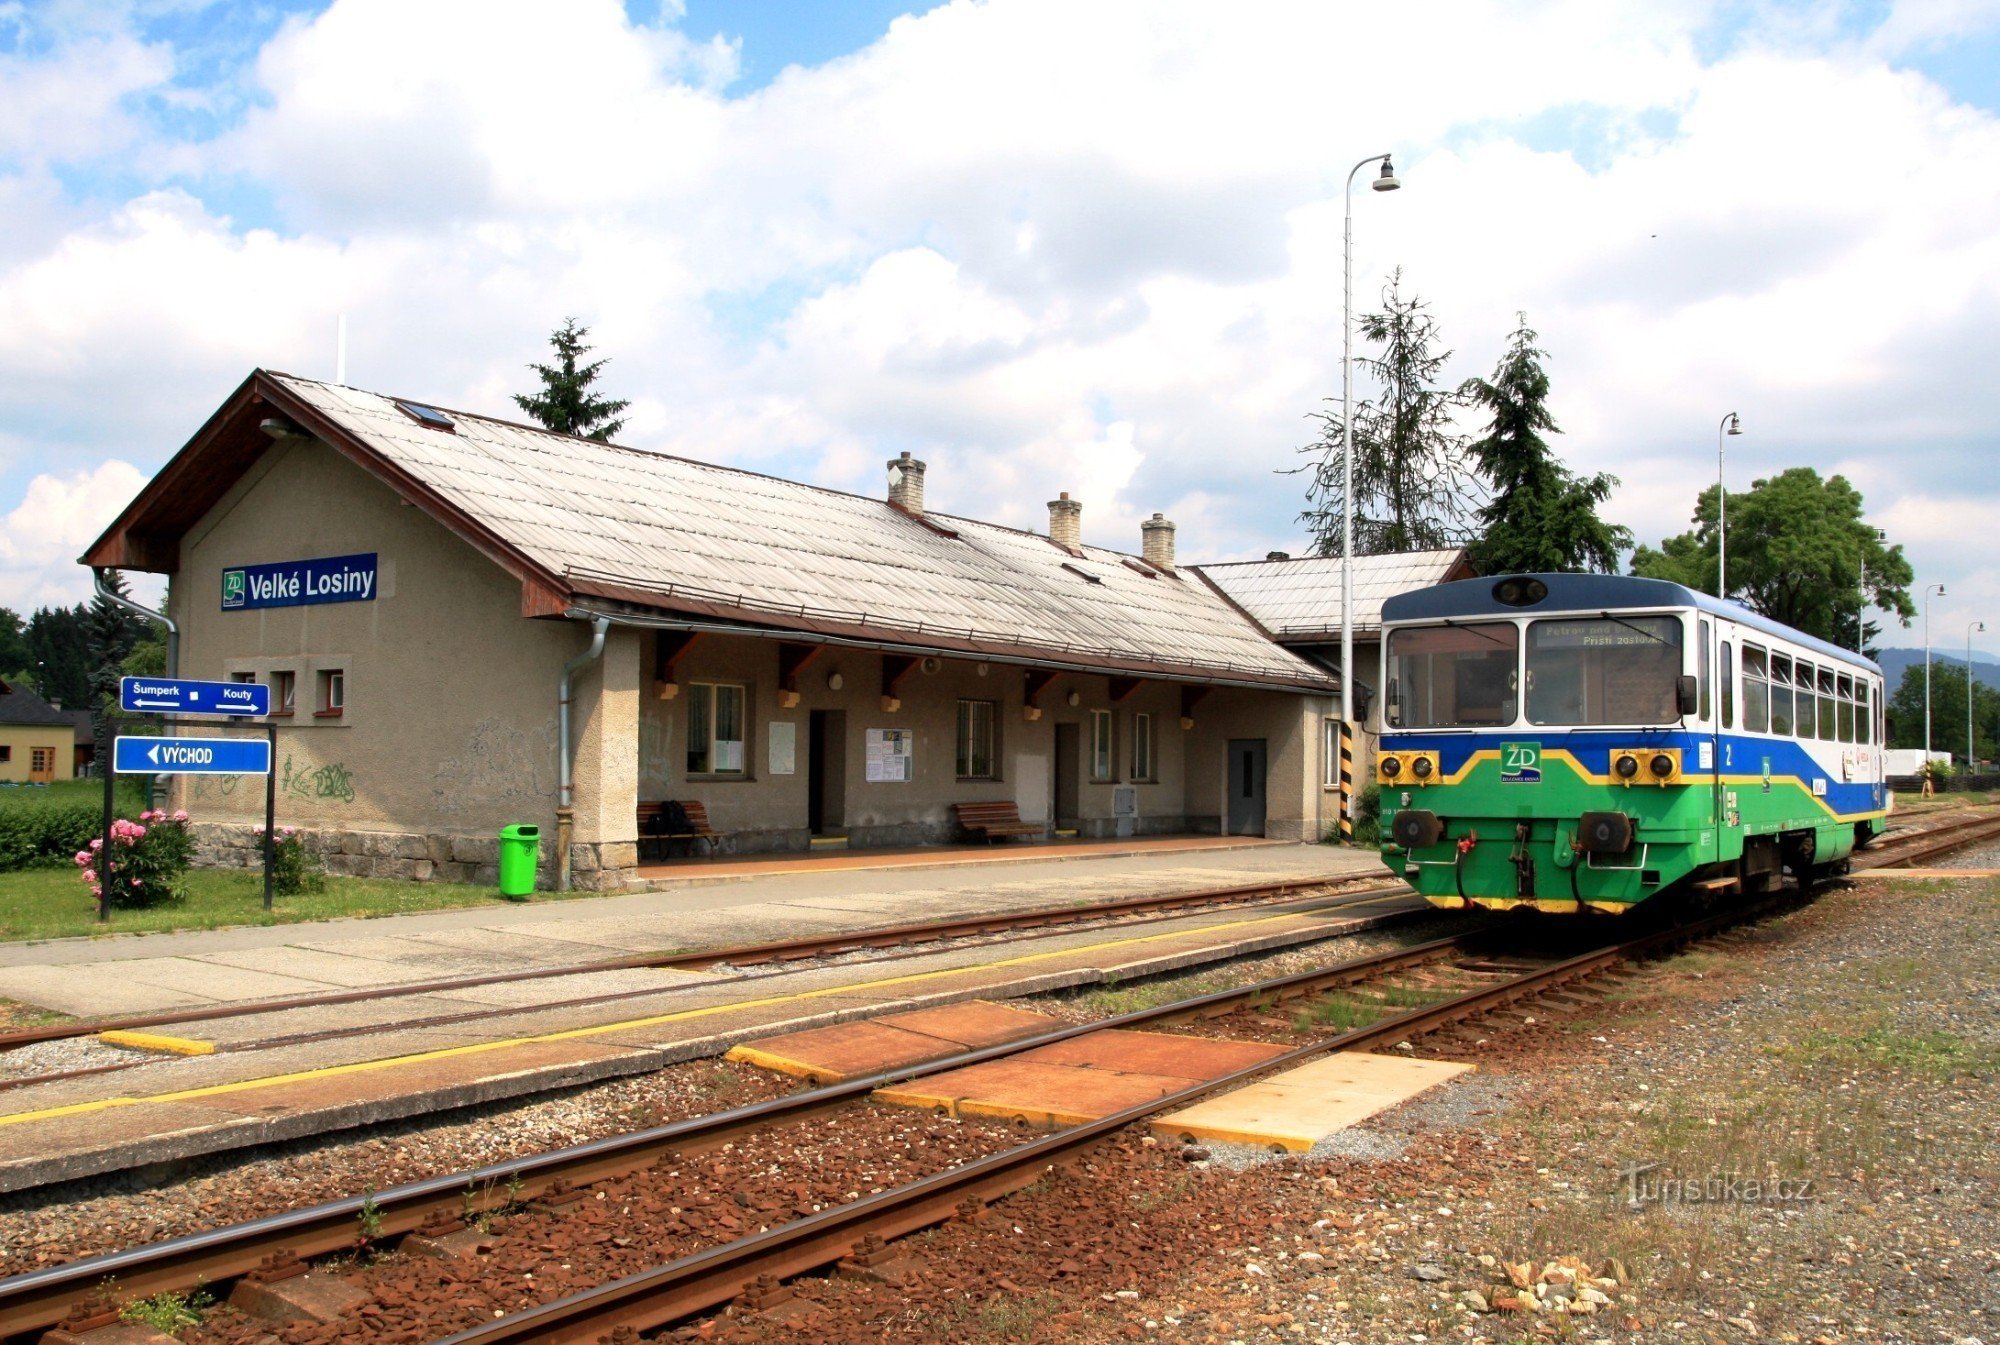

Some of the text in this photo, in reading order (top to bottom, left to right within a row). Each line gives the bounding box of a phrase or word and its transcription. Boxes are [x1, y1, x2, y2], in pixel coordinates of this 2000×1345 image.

[249, 566, 374, 600] Velké Losiny
[133, 681, 180, 697] Šumperk
[223, 688, 252, 700] Kouty
[162, 742, 213, 764] VÝCHOD
[1726, 744, 1732, 766] 2
